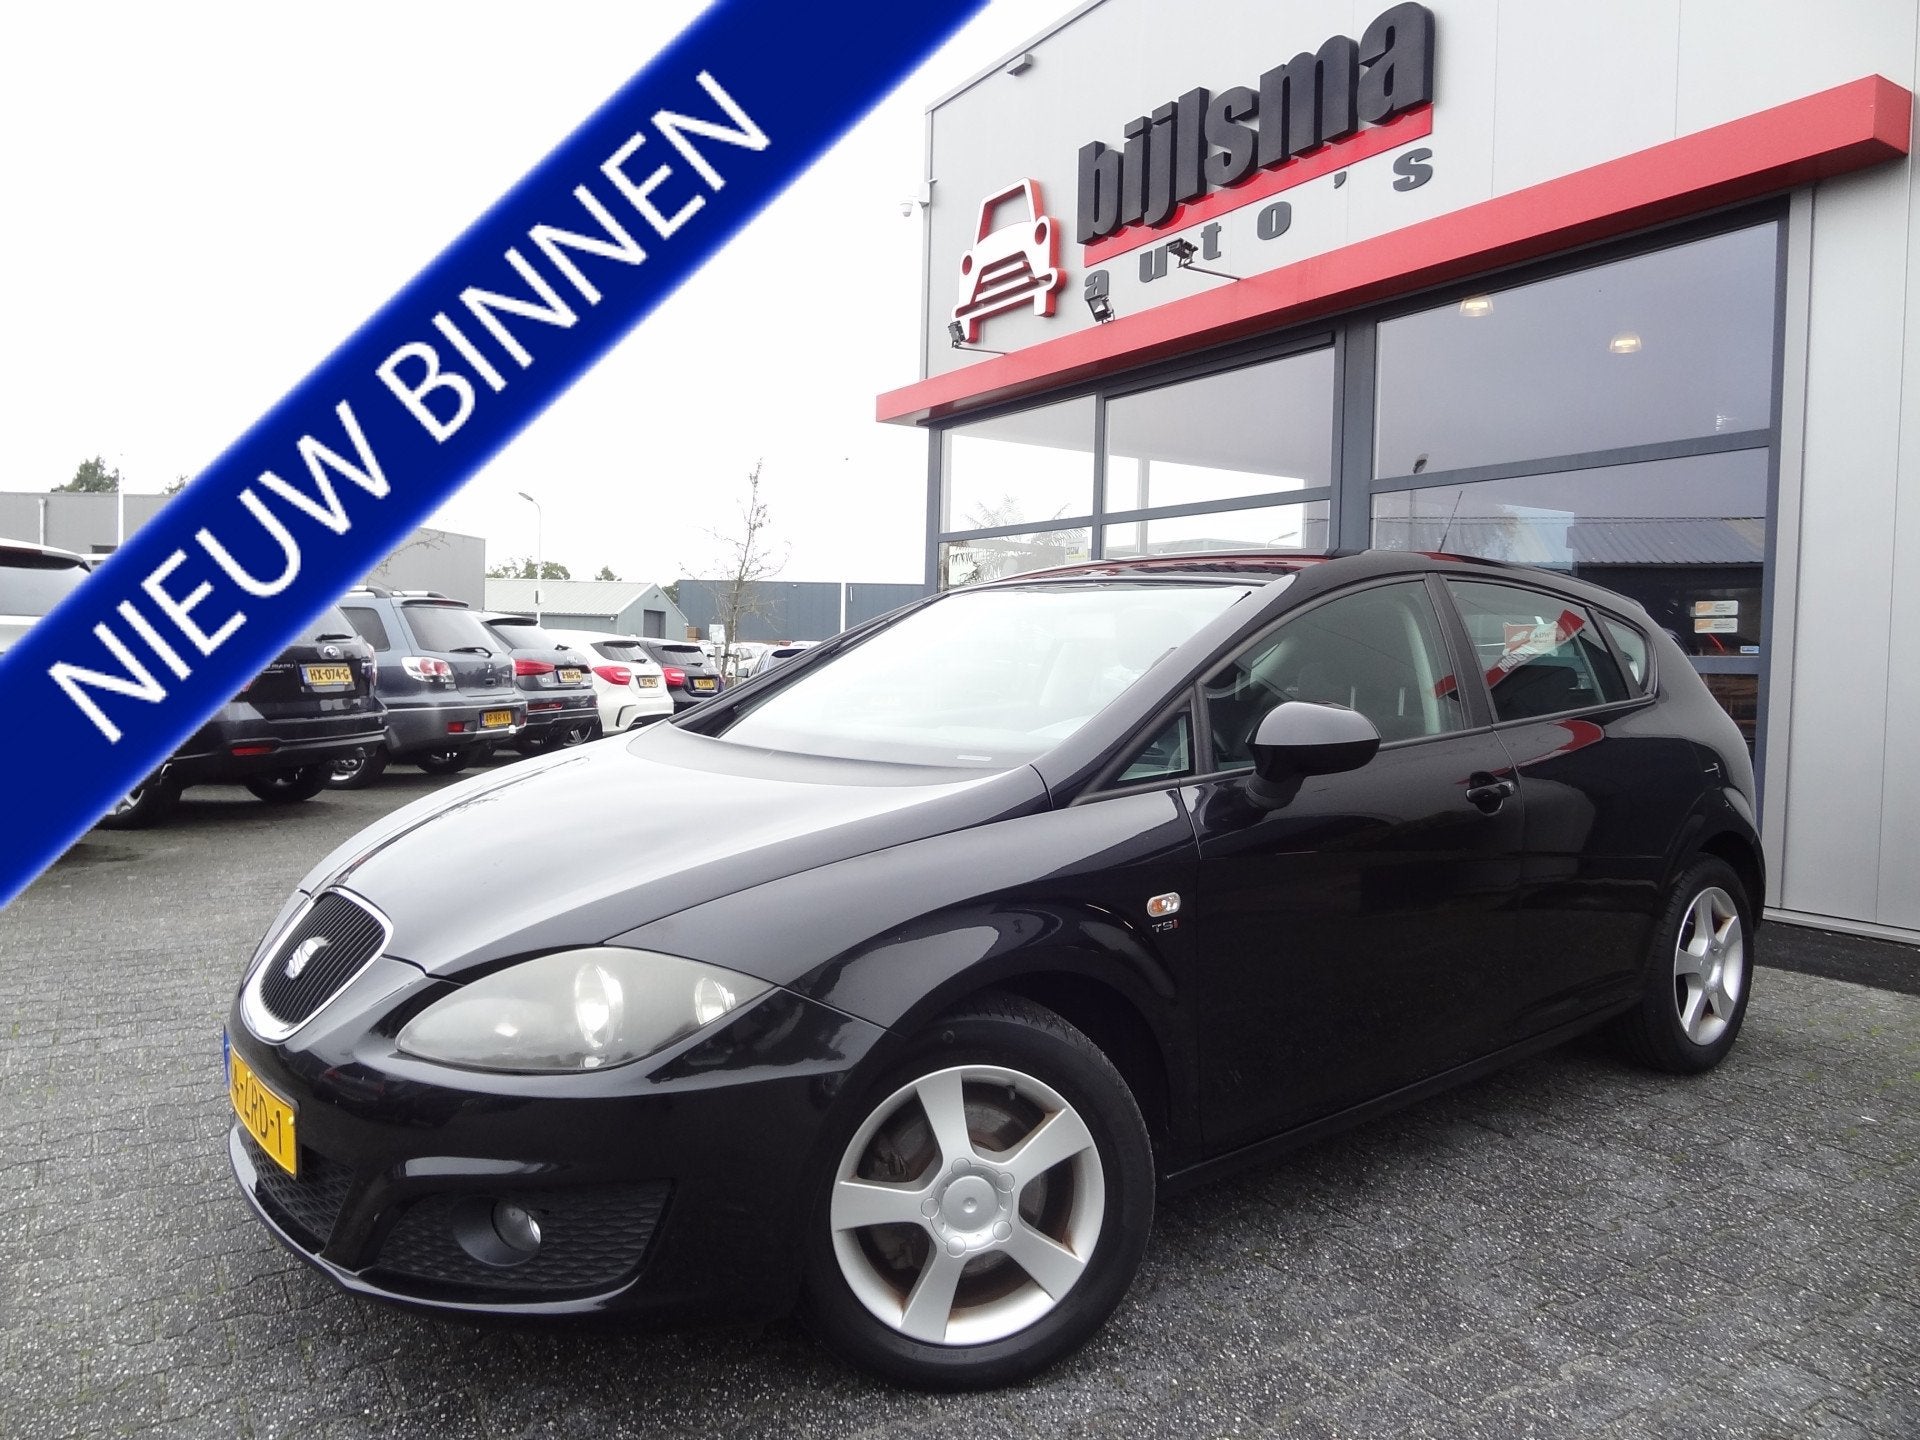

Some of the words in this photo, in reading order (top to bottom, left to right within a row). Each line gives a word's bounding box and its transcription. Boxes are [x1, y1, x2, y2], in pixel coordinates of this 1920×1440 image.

[1077, 1, 1435, 244] bijlsma
[1084, 147, 1434, 301] auto's
[309, 667, 350, 681] HX-074-G
